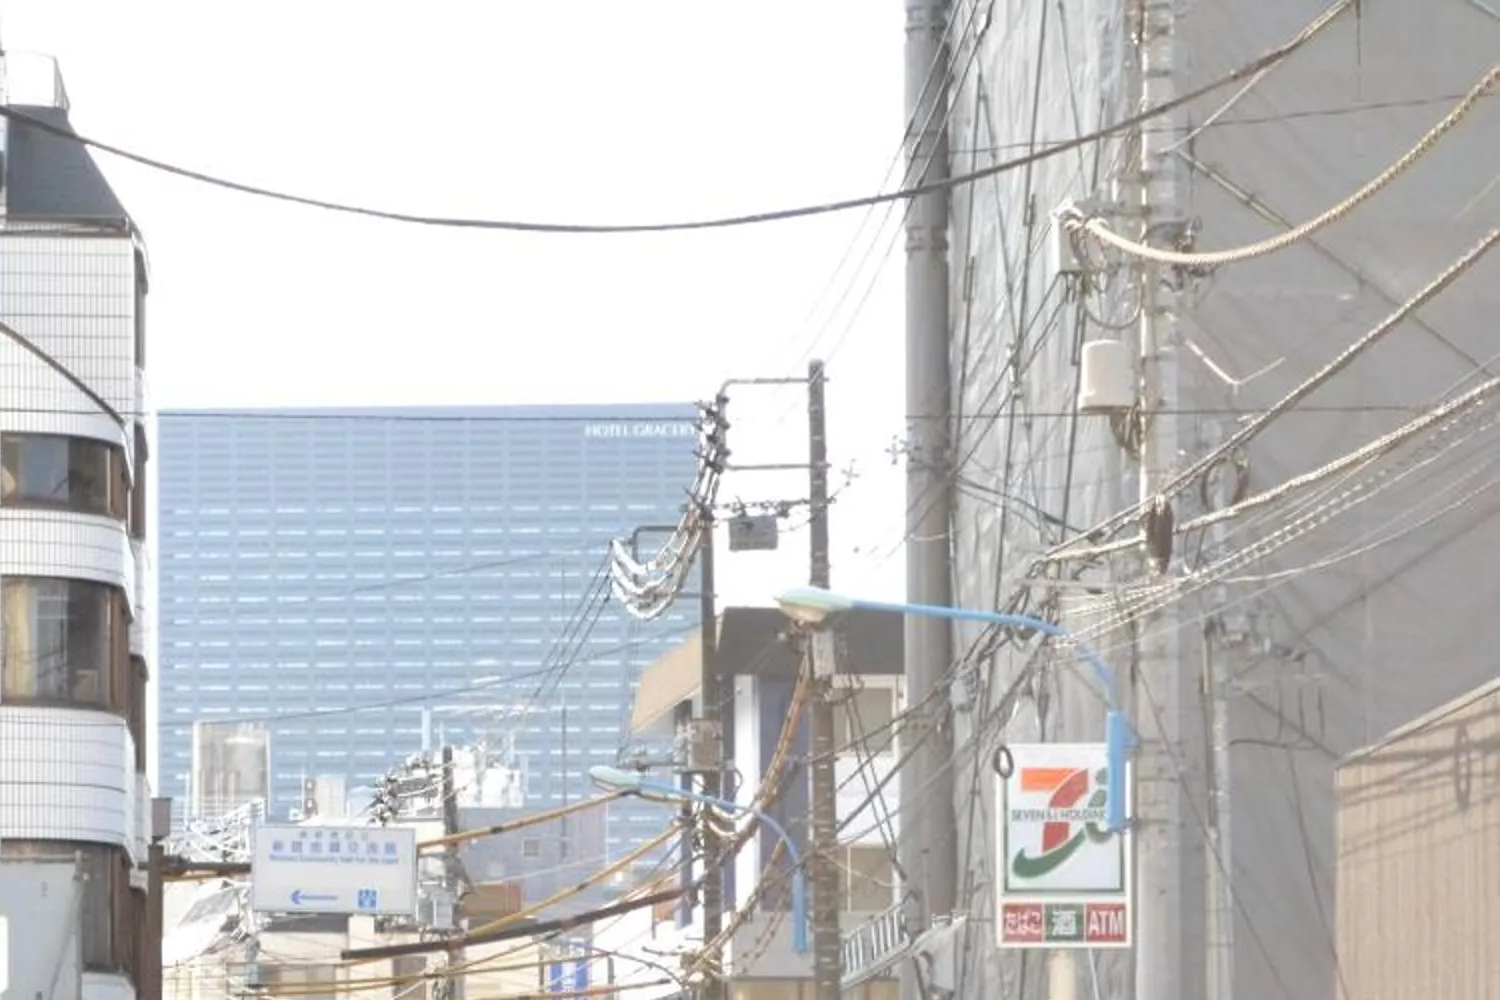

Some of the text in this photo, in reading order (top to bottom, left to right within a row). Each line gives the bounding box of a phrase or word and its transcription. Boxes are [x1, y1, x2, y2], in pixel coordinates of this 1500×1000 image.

[585, 423, 628, 437] HOTEL
[1004, 911, 1042, 936] たばこ
[1051, 909, 1078, 936] 酒
[1088, 911, 1125, 935] ATM
